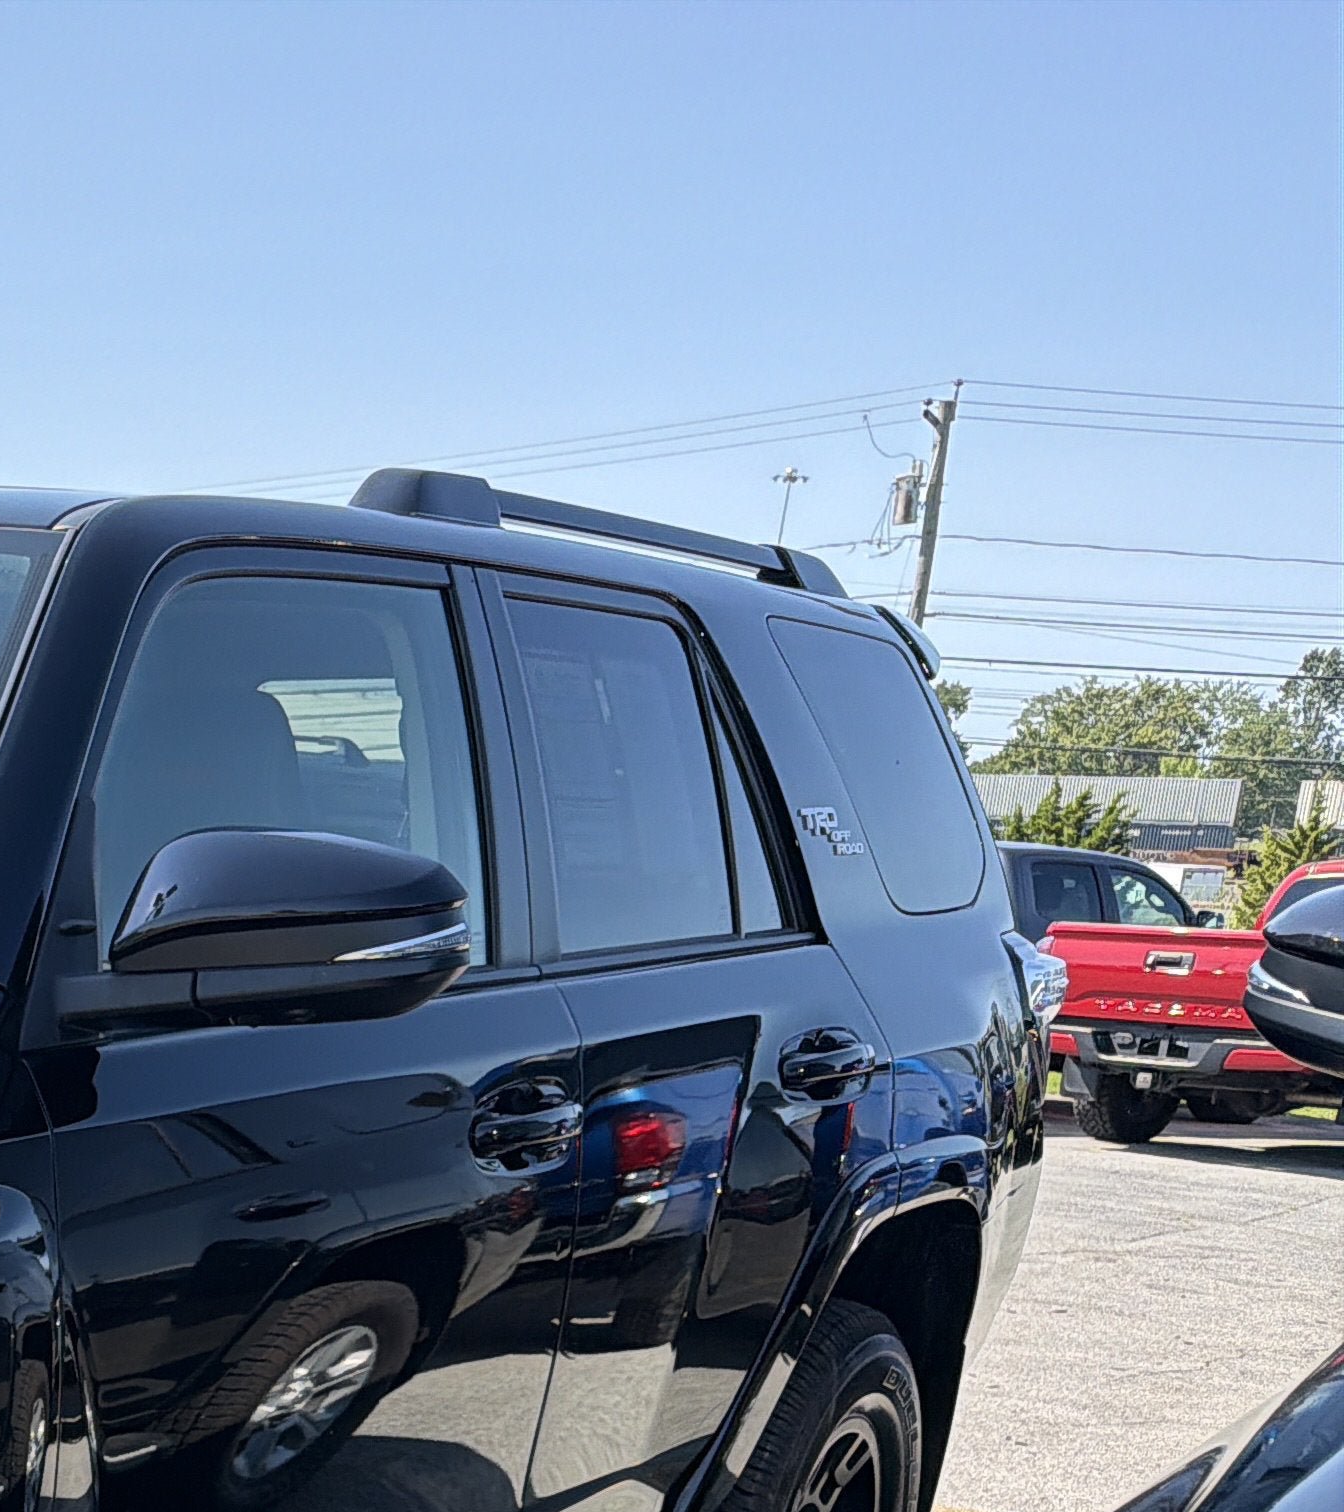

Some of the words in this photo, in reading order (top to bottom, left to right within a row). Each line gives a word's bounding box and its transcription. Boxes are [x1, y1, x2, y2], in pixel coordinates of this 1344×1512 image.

[798, 806, 839, 836] TRD
[830, 831, 852, 842] OFF
[834, 842, 865, 855] ROAD
